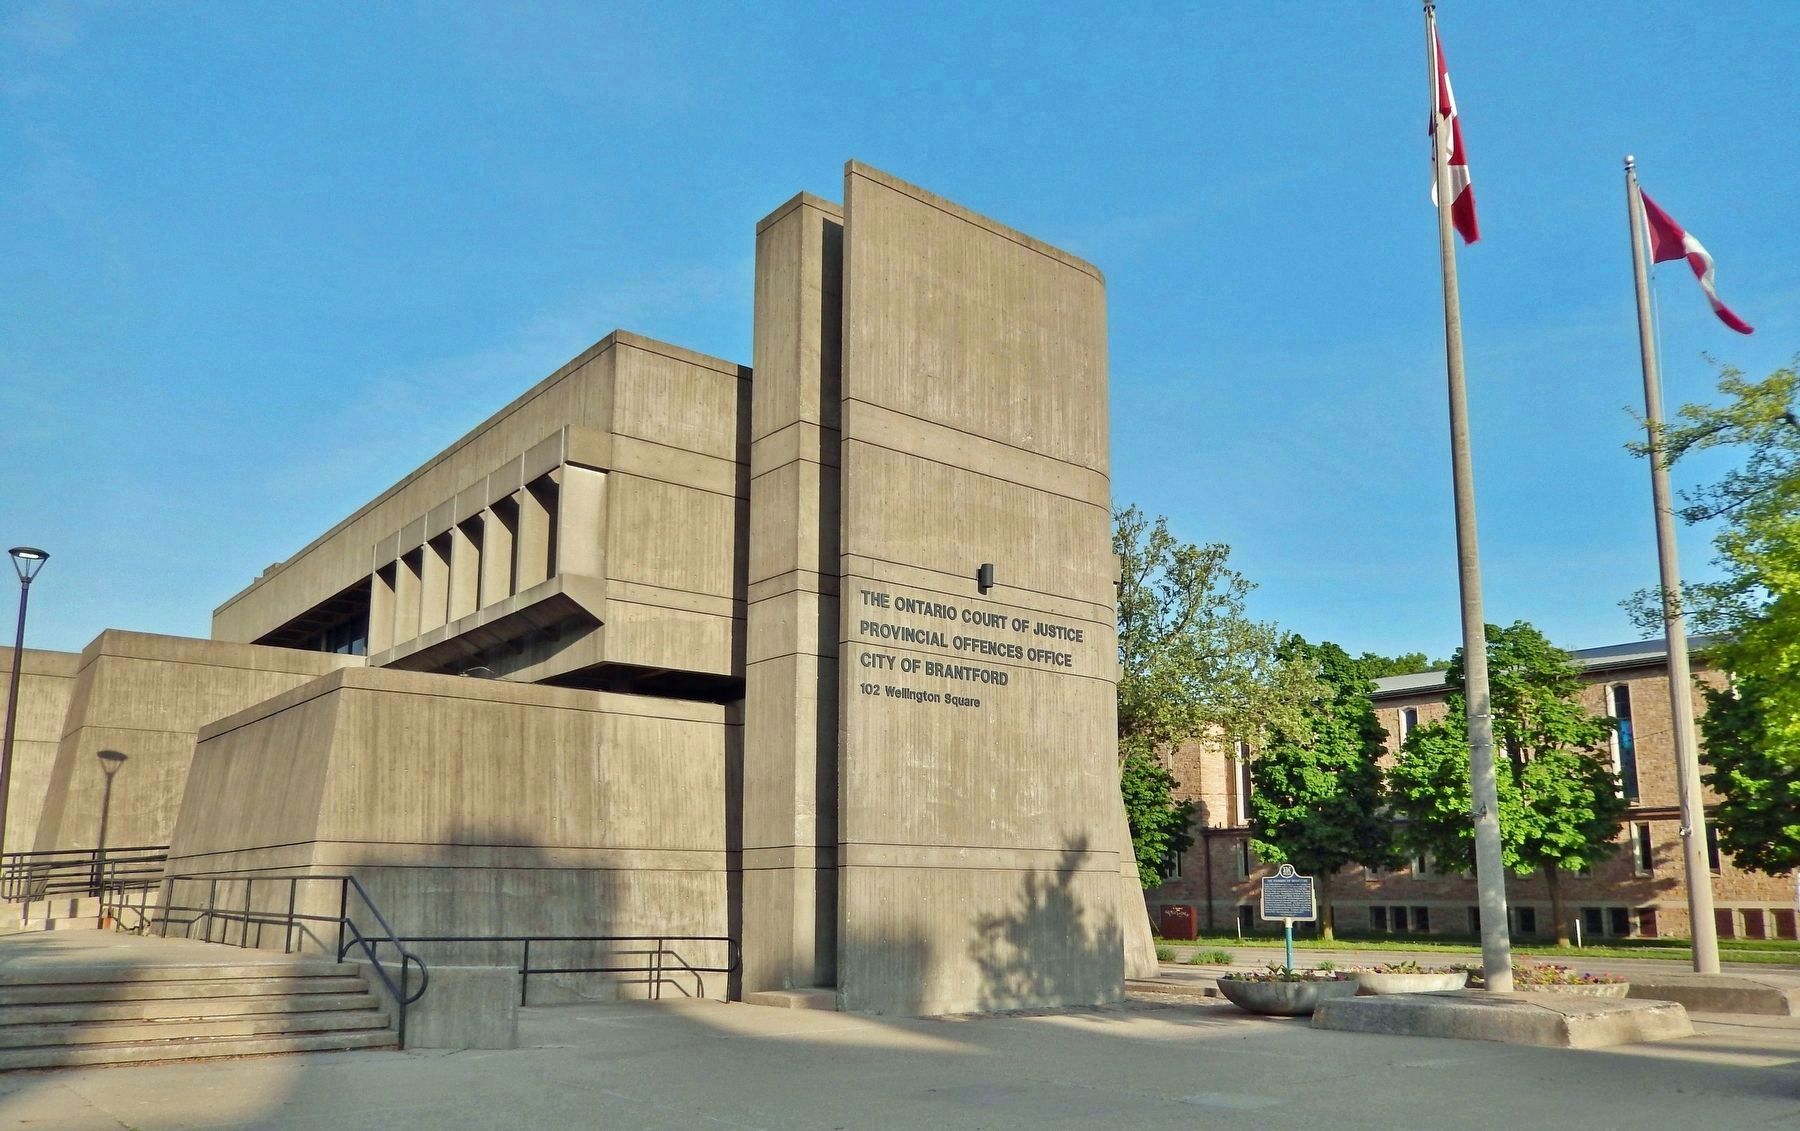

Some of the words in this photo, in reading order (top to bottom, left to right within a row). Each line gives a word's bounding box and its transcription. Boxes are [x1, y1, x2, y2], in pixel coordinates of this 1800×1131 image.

[861, 590, 890, 608] THE
[894, 596, 957, 620] ONTARIO
[961, 609, 1008, 629] COURT
[1011, 618, 1029, 632] OF
[1033, 622, 1084, 643] JUSTICE
[860, 620, 949, 648] PROVINCIAL
[952, 636, 1023, 659] OFFENCES
[1027, 648, 1073, 667] OFFICE
[860, 652, 896, 670] CITY
[900, 658, 921, 673] OF
[925, 661, 1009, 686] BRANTFORD
[860, 683, 880, 696] 102
[885, 685, 940, 704] Wellington
[944, 693, 981, 707] Square
